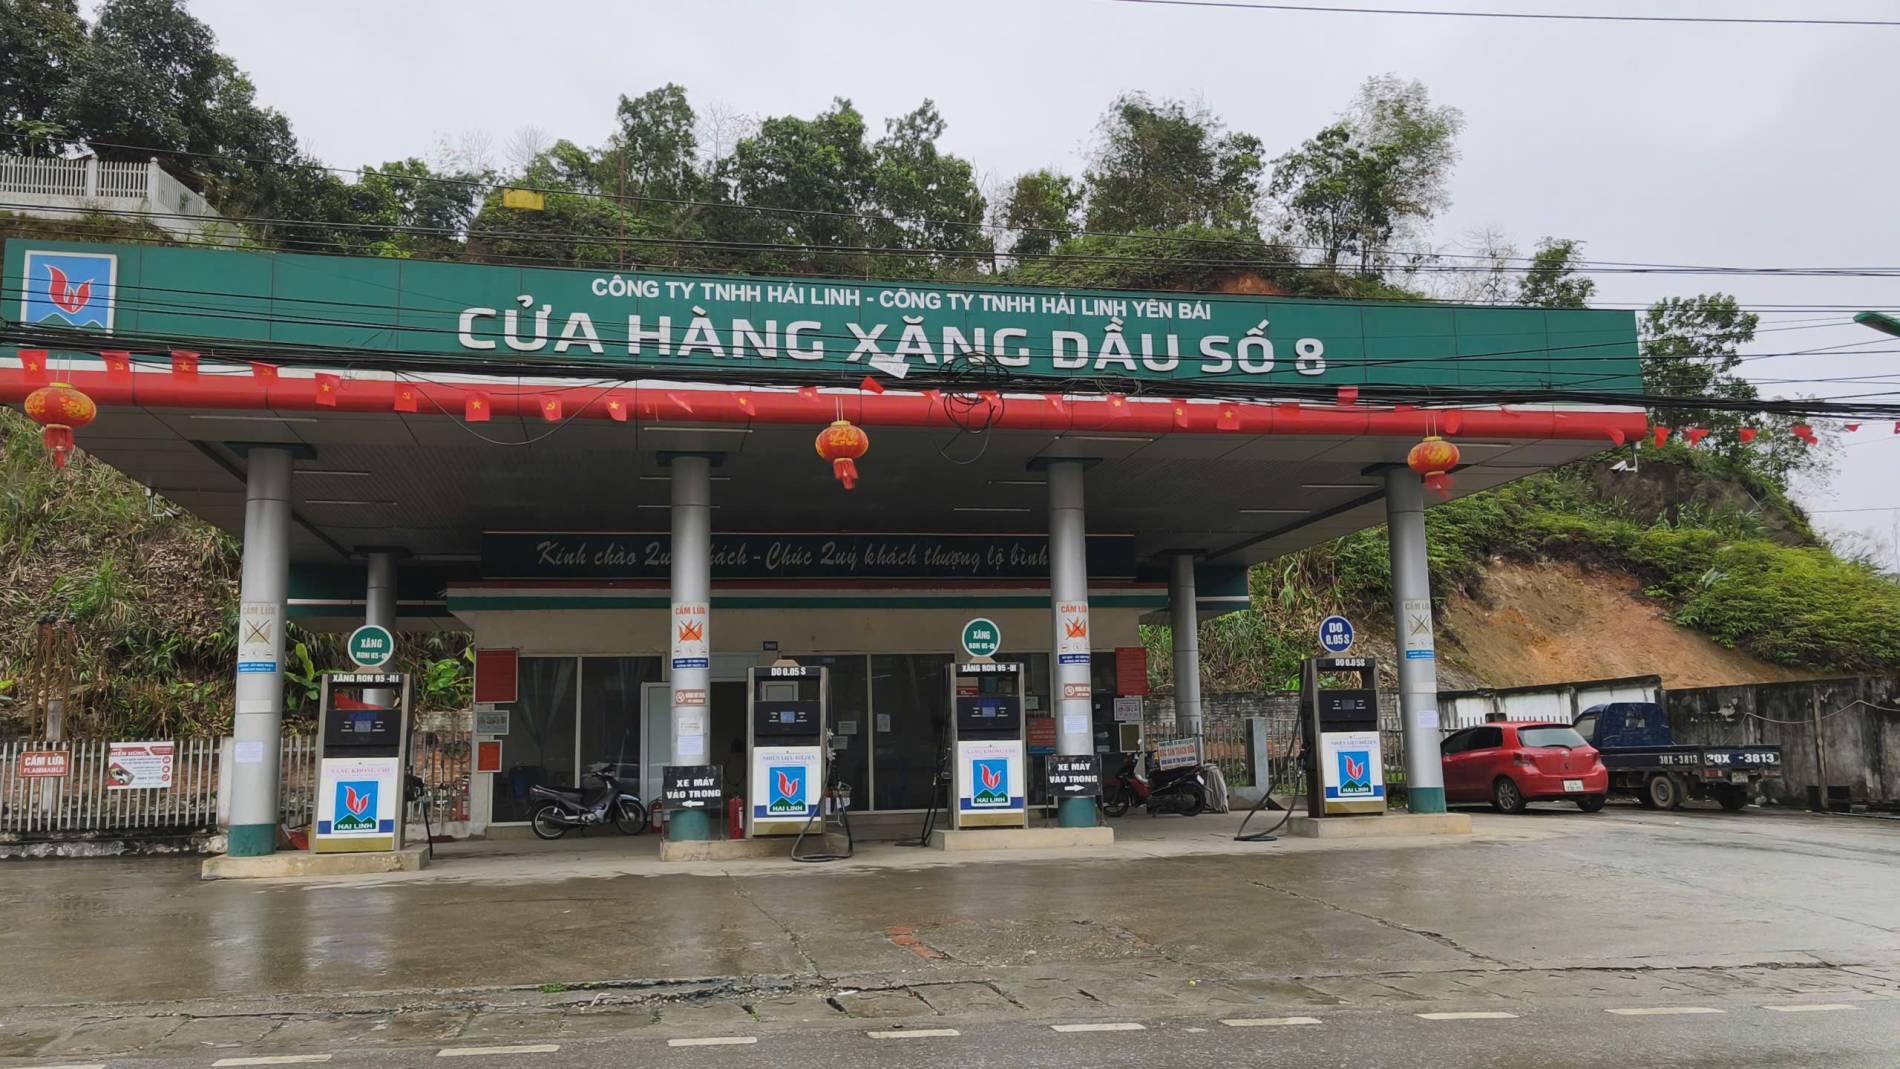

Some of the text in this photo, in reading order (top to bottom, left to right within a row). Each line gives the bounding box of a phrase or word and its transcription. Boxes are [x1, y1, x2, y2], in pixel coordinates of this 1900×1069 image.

[592, 275, 659, 298] CÔNG
[665, 281, 695, 300] TY
[701, 283, 761, 302] TNHH
[811, 288, 860, 306] LINH
[879, 286, 941, 309] CÔNG
[947, 293, 973, 311] TY
[979, 295, 1035, 313] TNHH
[1082, 297, 1126, 317] LINH
[1132, 297, 1172, 319] YÊN
[1178, 299, 1212, 320] BÁI
[458, 295, 1327, 376] CỬA HÀNG XĂNG DẦU SỐ 8
[536, 540, 586, 566] Kính
[594, 542, 637, 566] chào
[645, 542, 672, 566] Qu
[709, 543, 748, 566] hách
[765, 541, 812, 570] Chúc
[820, 541, 857, 571] Quý
[864, 543, 917, 566] khách
[924, 543, 981, 573] thượng
[987, 543, 1004, 571] lộ
[1010, 543, 1049, 566] bình
[1329, 622, 1343, 633] DO
[973, 629, 991, 640] XĂNG
[360, 637, 383, 648] XĂNG
[962, 663, 981, 672] XĂNG
[982, 664, 996, 672] RON
[997, 664, 1006, 672] 95
[1335, 658, 1345, 667] DO
[771, 666, 807, 677] DO 0.05 S
[332, 673, 355, 683] XĂNG
[356, 674, 373, 683] RON
[24, 752, 65, 767] CẤM LỬA
[1057, 760, 1091, 771] XE MÁY
[676, 776, 715, 787] XE MÁY
[1049, 773, 1098, 783] VÀO TRONG
[666, 788, 721, 799] VÀO TRONG
